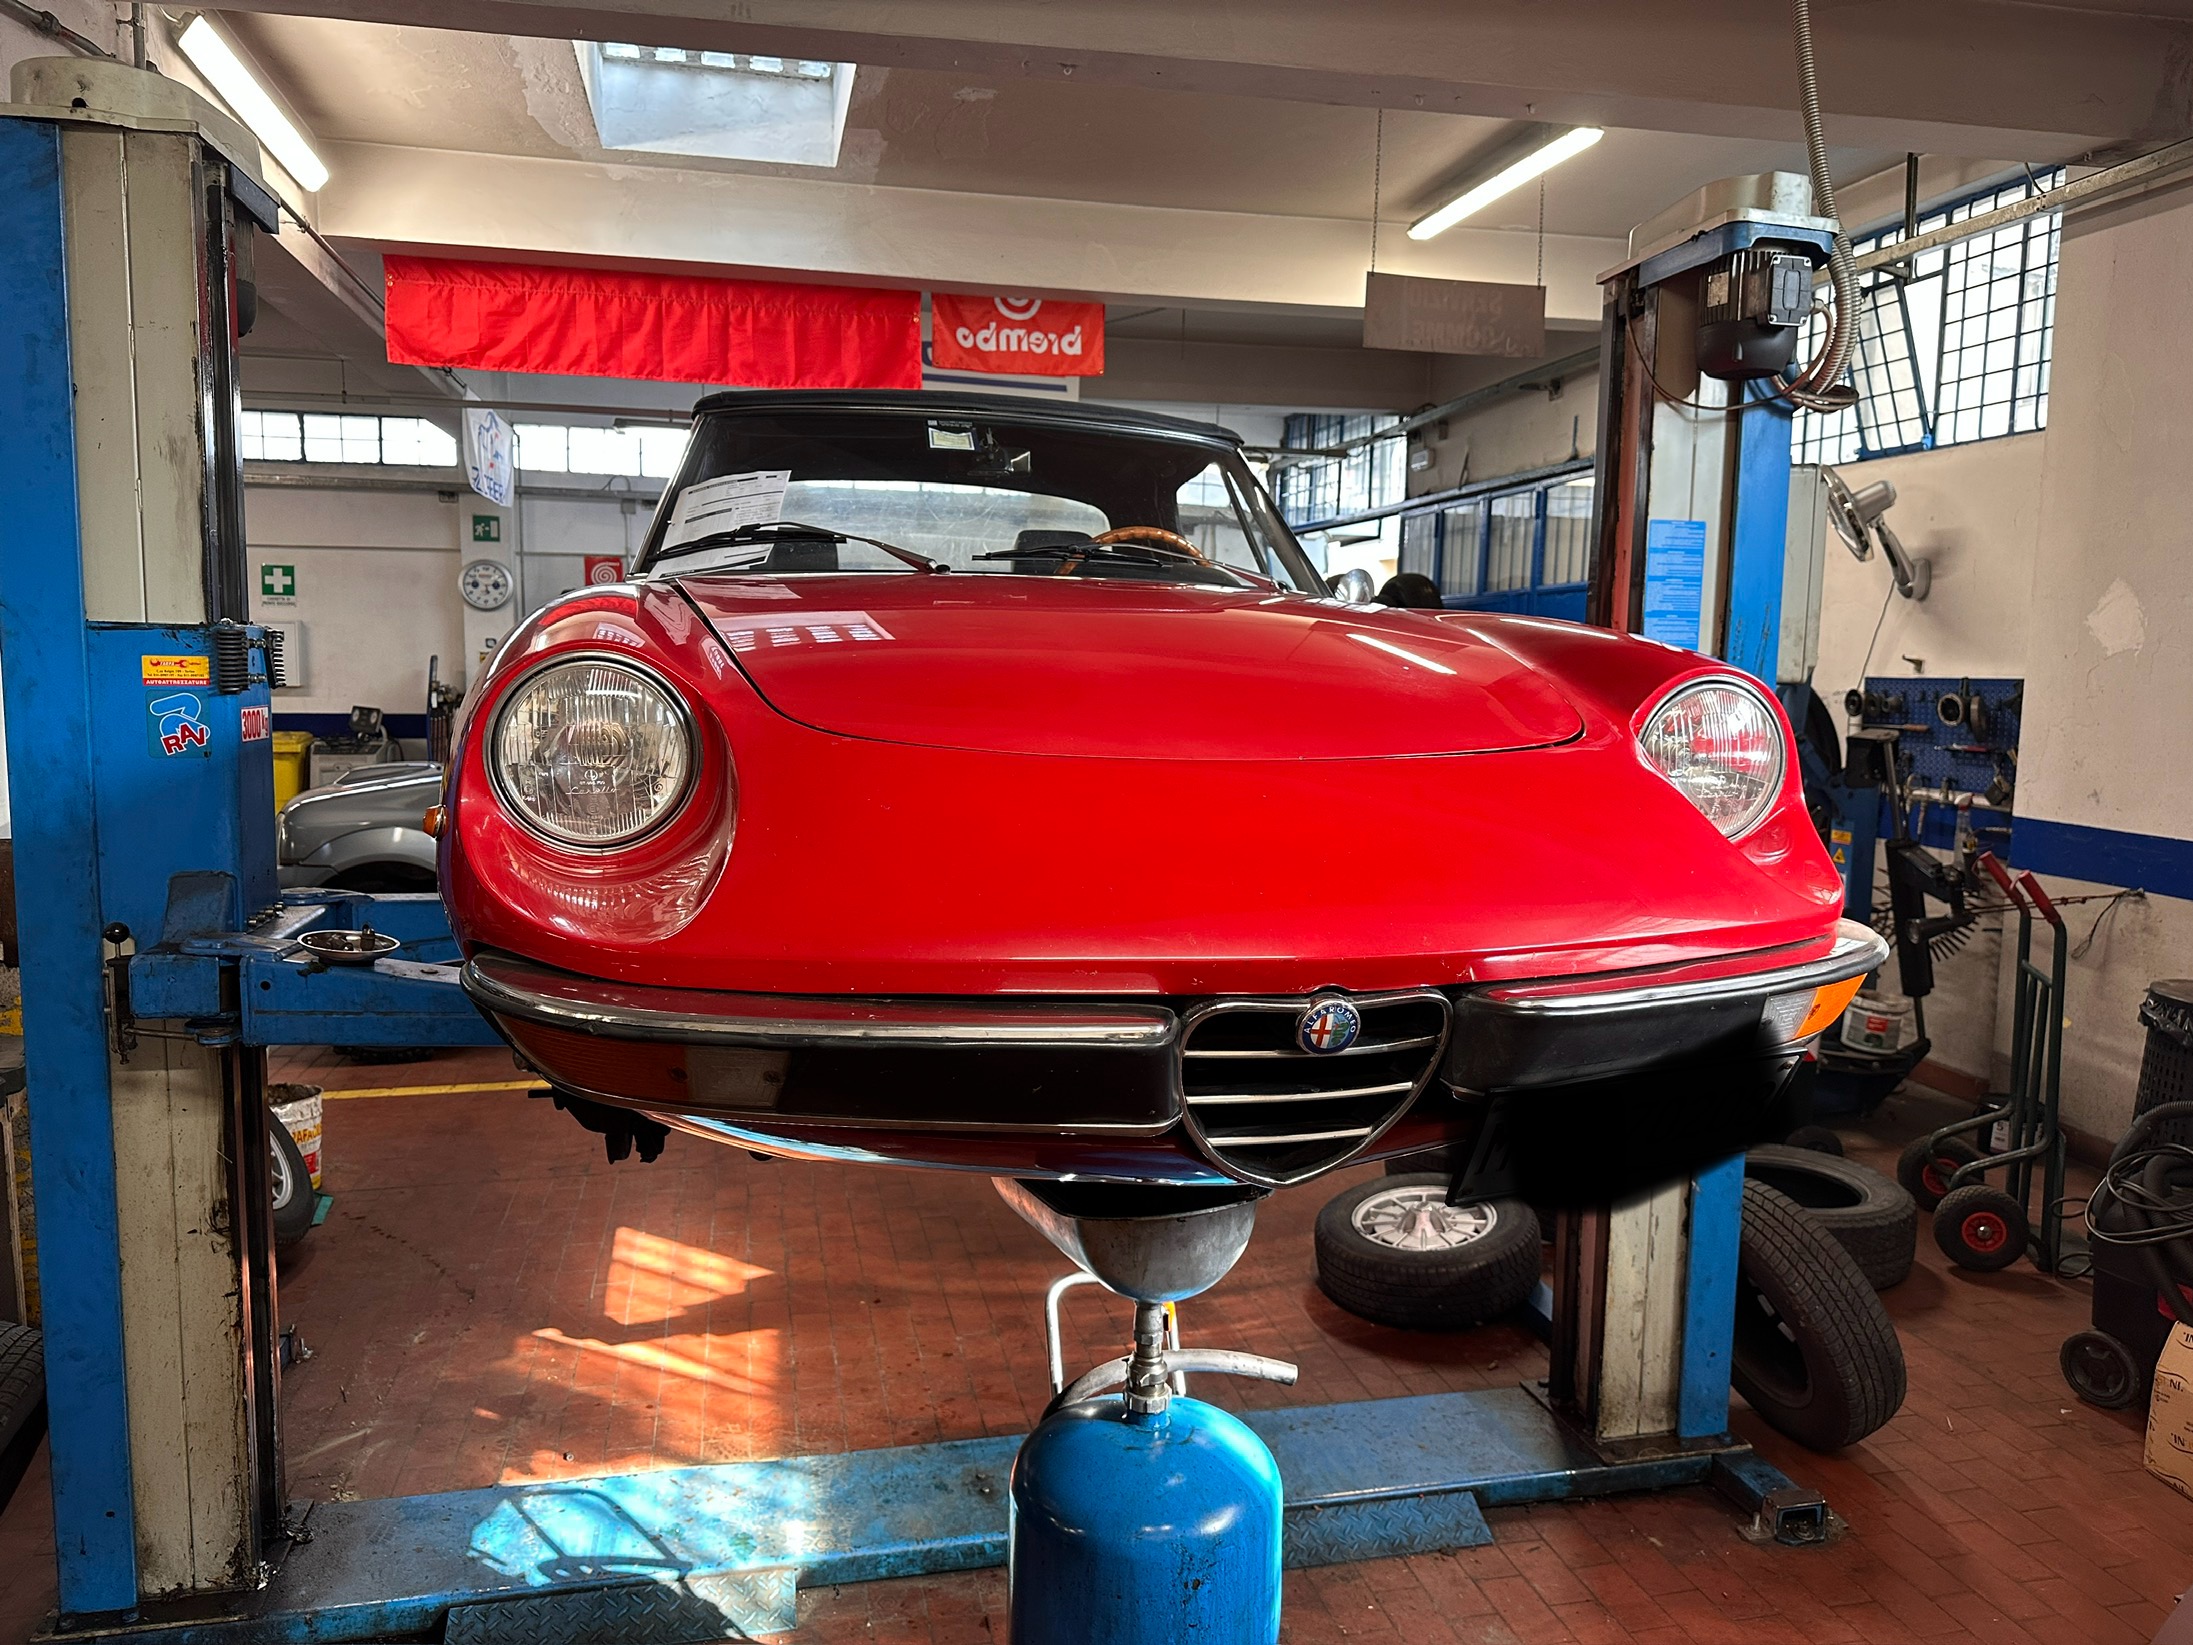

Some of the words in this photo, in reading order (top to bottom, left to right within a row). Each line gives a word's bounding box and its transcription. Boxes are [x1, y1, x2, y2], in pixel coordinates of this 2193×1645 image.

[161, 722, 206, 755] RAV
[242, 709, 261, 740] 3000
[261, 709, 269, 737] kg
